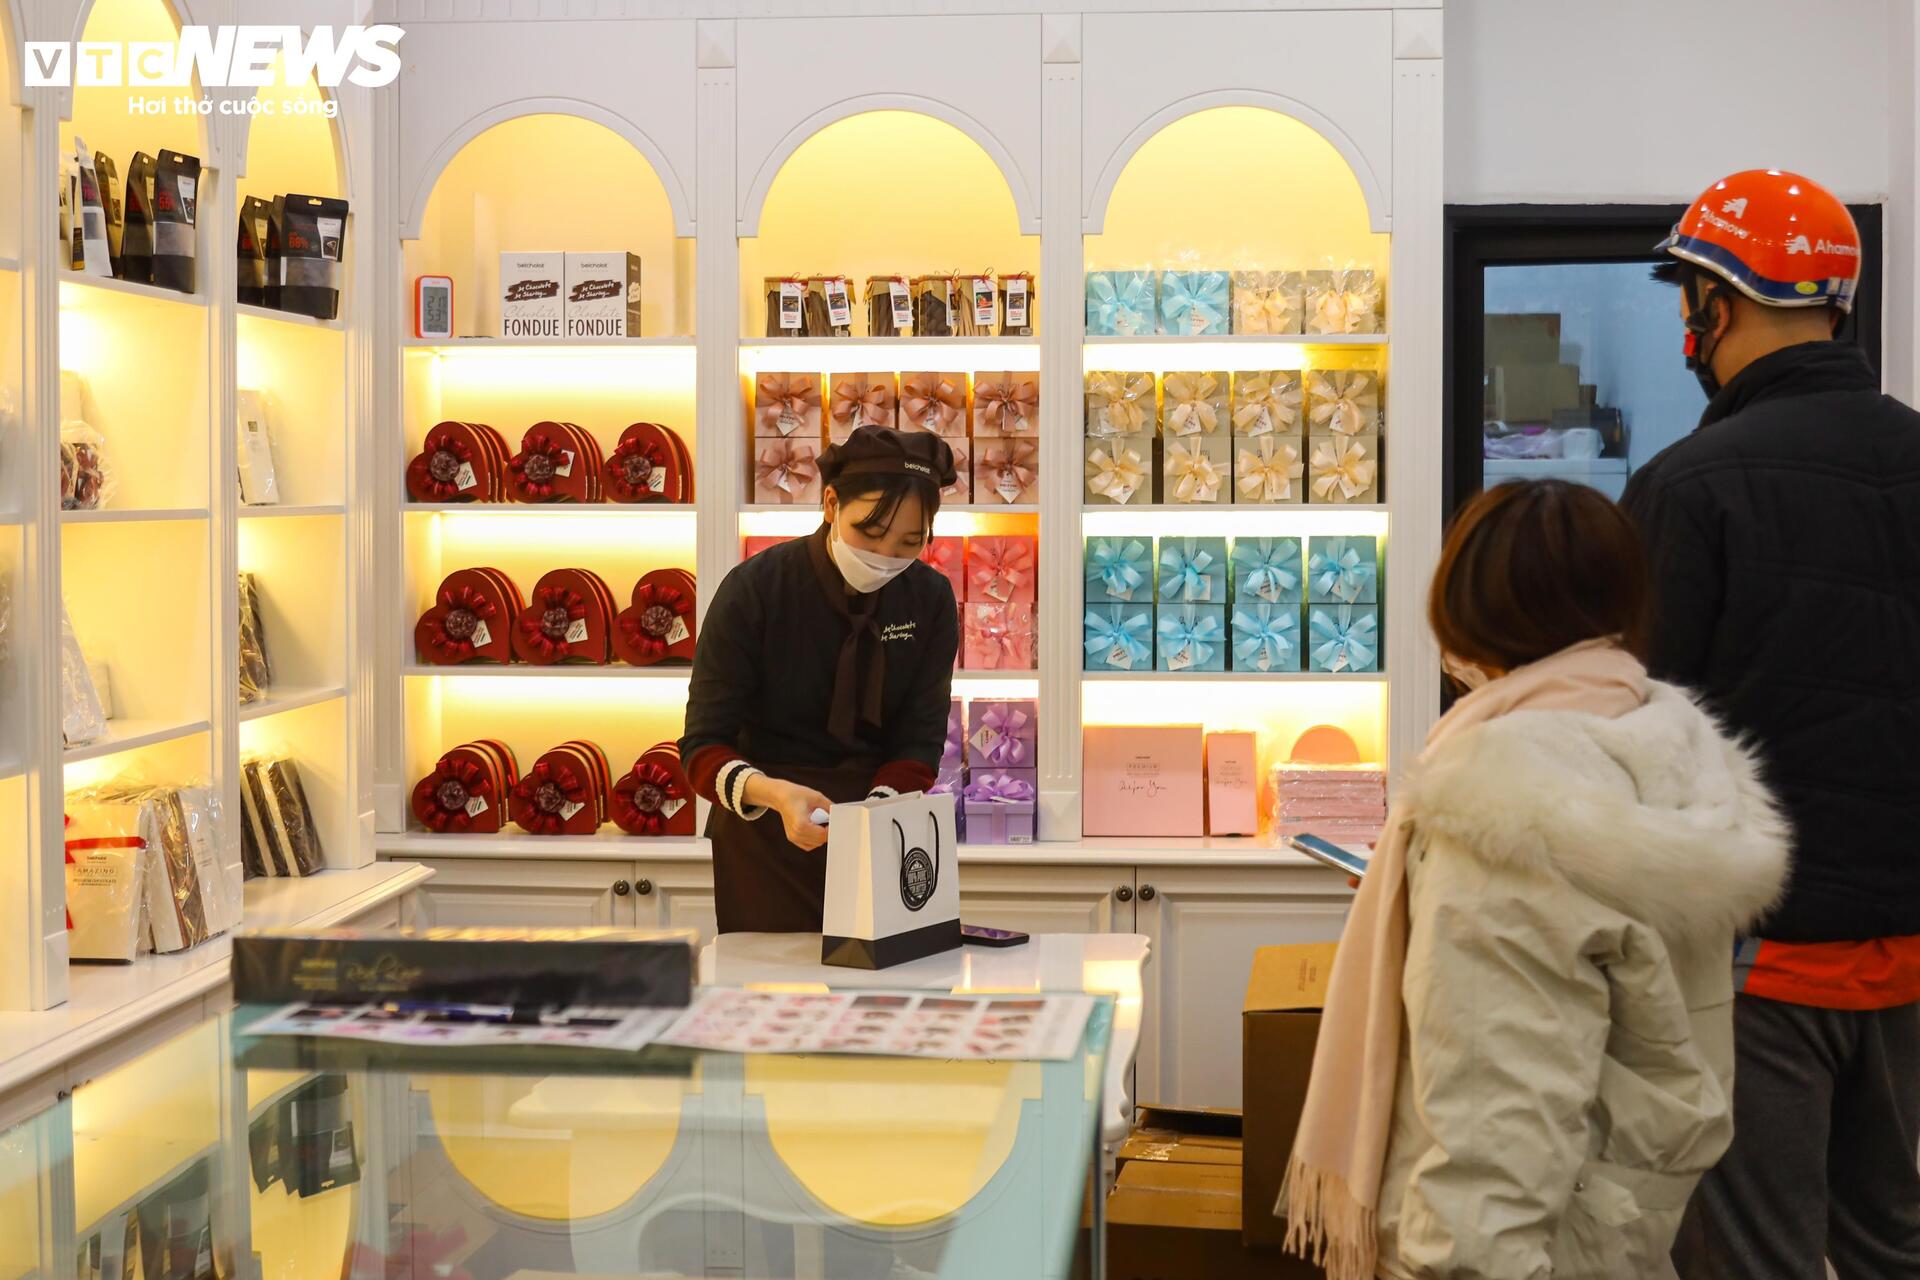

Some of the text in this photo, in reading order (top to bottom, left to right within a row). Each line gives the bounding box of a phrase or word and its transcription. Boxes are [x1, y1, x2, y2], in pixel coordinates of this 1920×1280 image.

[1700, 209, 1749, 240] Ahamove
[504, 319, 560, 336] FONDUE
[568, 319, 623, 336] FONDUE
